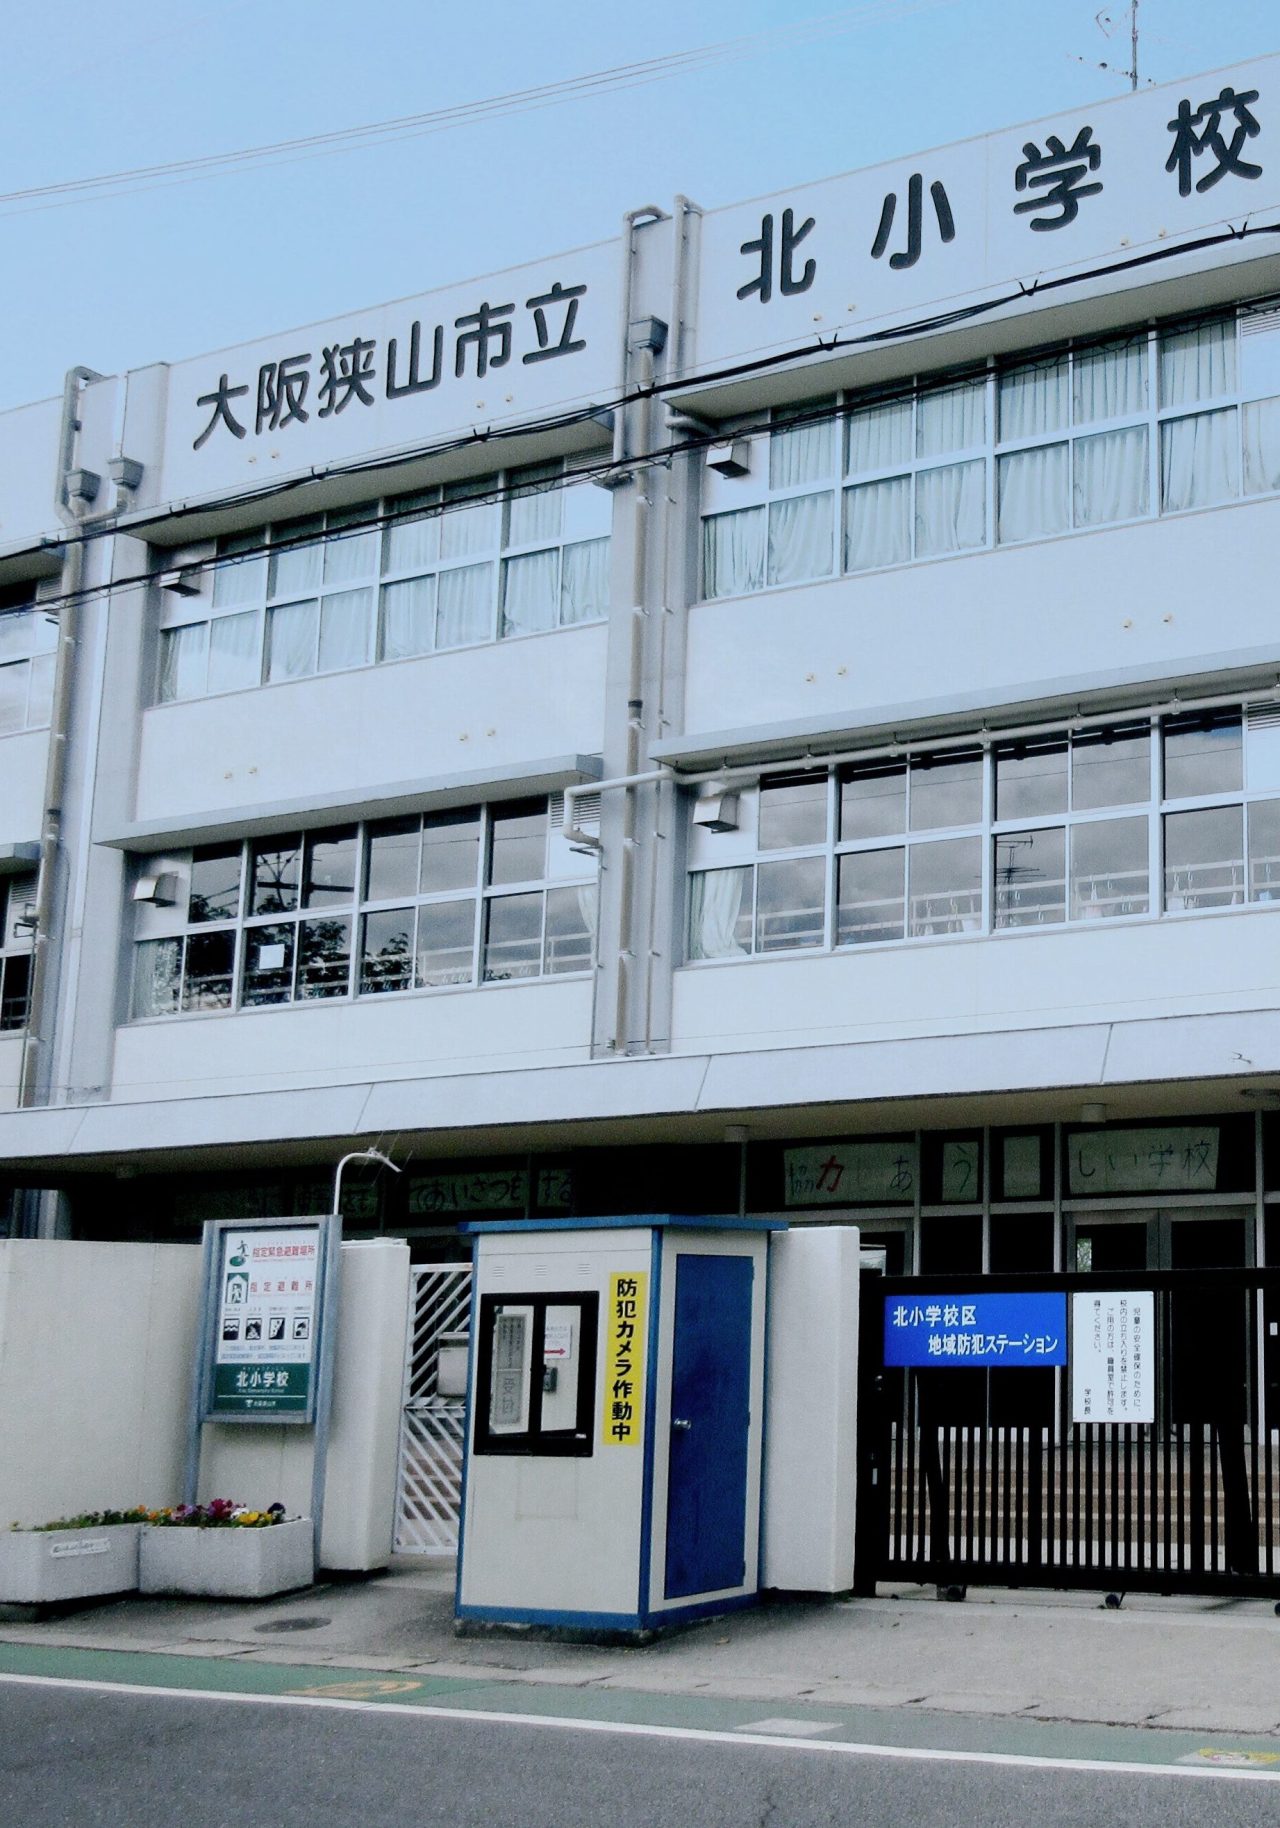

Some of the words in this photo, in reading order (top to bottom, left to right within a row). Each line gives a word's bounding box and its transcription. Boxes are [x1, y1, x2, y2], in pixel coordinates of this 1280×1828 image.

[193, 281, 588, 451] 大阪狭山市立
[736, 86, 1263, 303] 北小学校
[893, 1304, 977, 1327] 北小学校区
[928, 1333, 1058, 1356] 地域防犯ステーション
[611, 1278, 637, 1441] 防犯カメラ作動中
[236, 1371, 289, 1388] 北小学校
